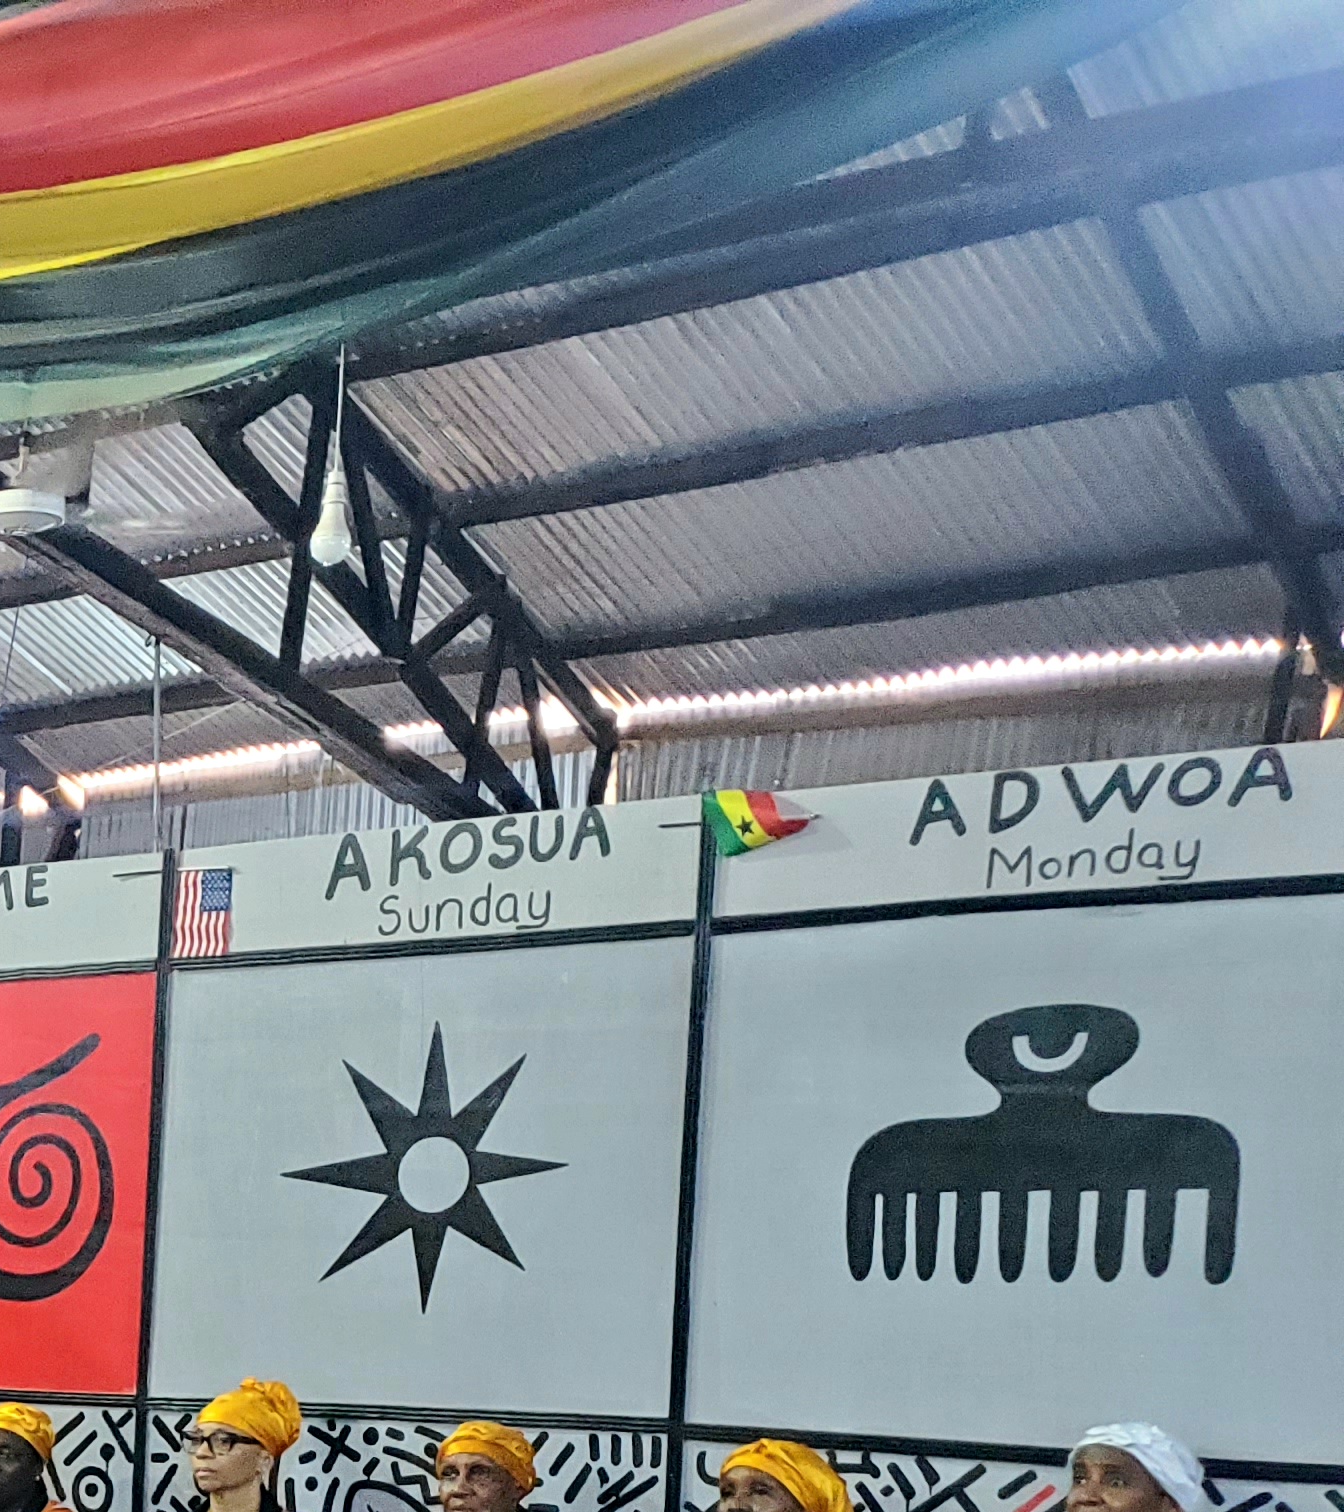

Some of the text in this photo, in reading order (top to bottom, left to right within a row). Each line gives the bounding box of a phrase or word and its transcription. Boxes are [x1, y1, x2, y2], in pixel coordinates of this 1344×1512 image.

[910, 747, 1293, 846] ADWOA
[324, 806, 614, 901] AKOSUA
[986, 827, 1202, 889] Monday
[378, 883, 553, 938] Sunday
